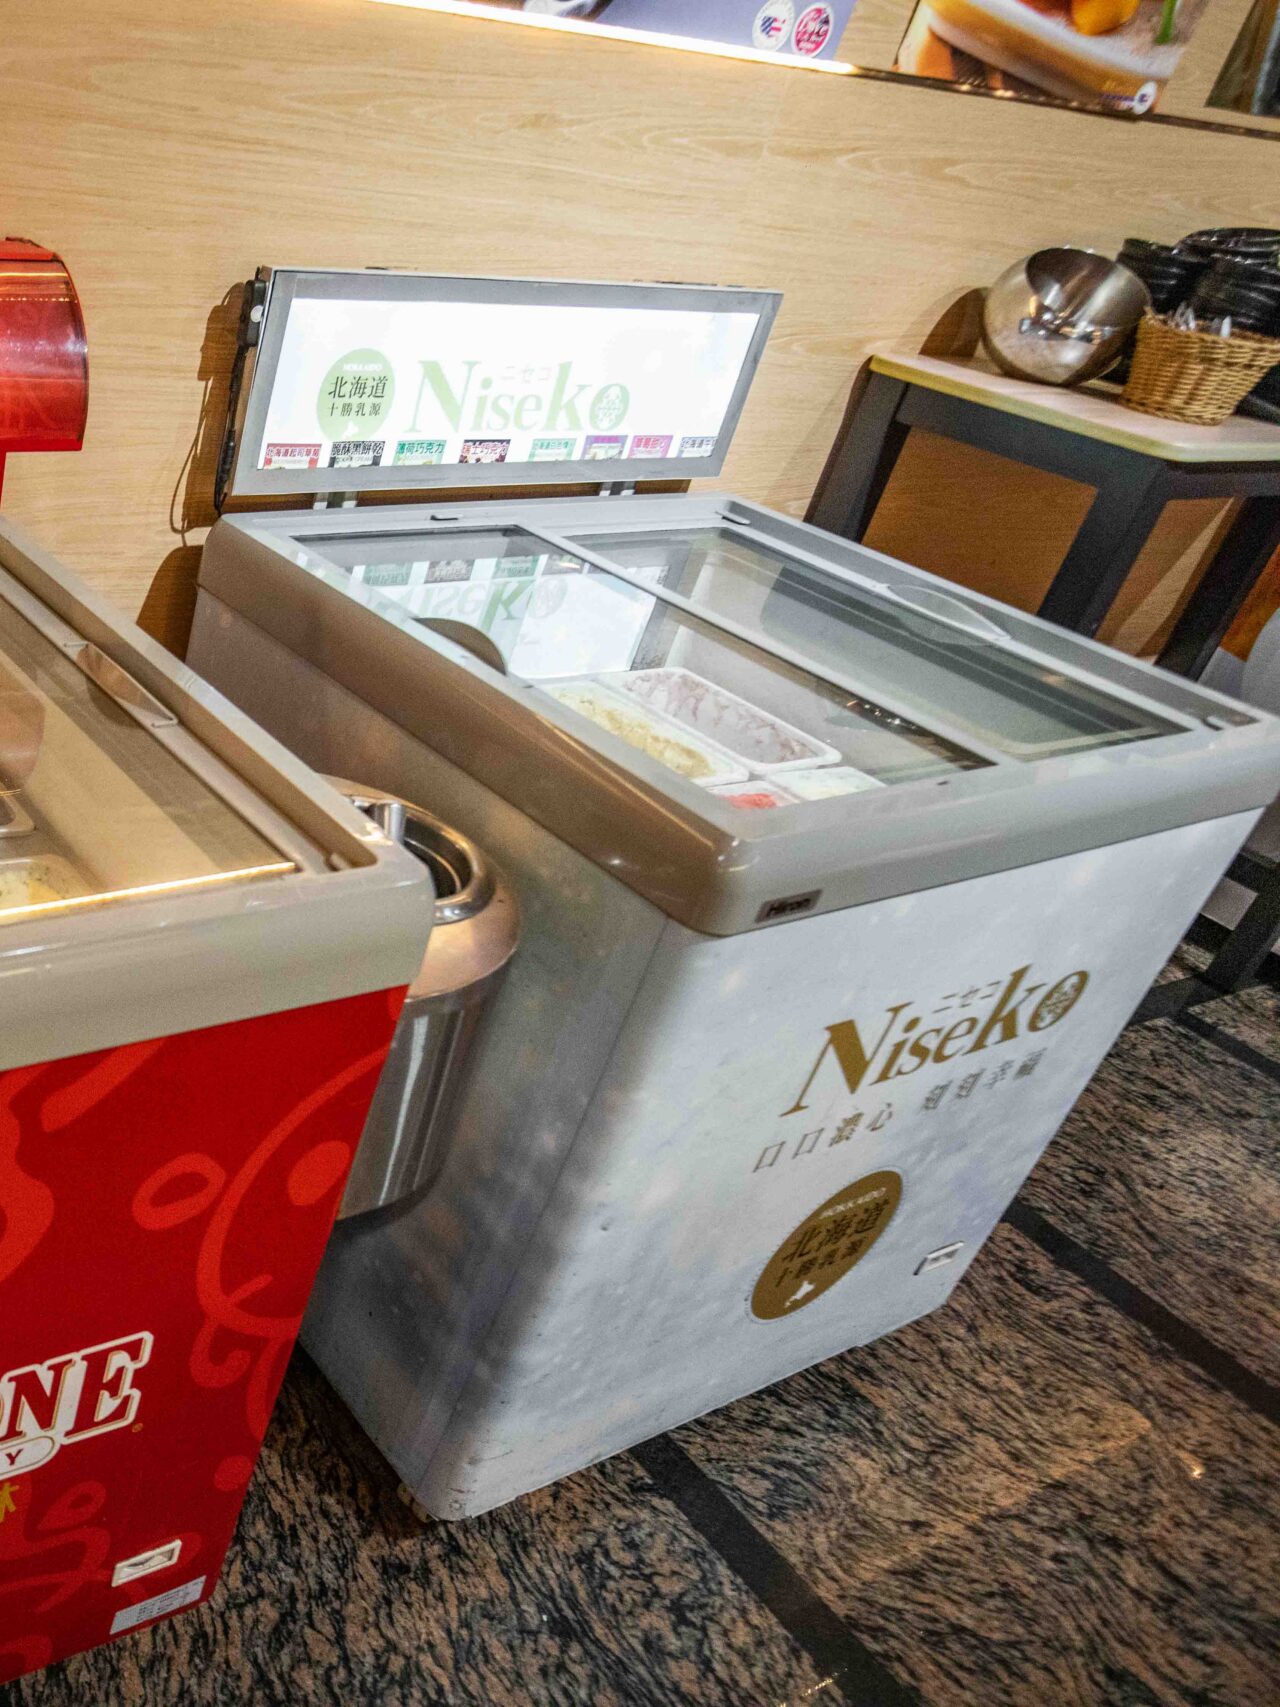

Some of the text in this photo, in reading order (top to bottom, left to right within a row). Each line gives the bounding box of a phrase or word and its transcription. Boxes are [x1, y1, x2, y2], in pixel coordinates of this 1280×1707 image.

[328, 376, 388, 399] 北海道
[328, 402, 382, 417] 十勝乳源
[403, 360, 631, 434] Niseko
[779, 963, 1090, 1118] Niseko
[781, 1198, 890, 1263] 北海道
